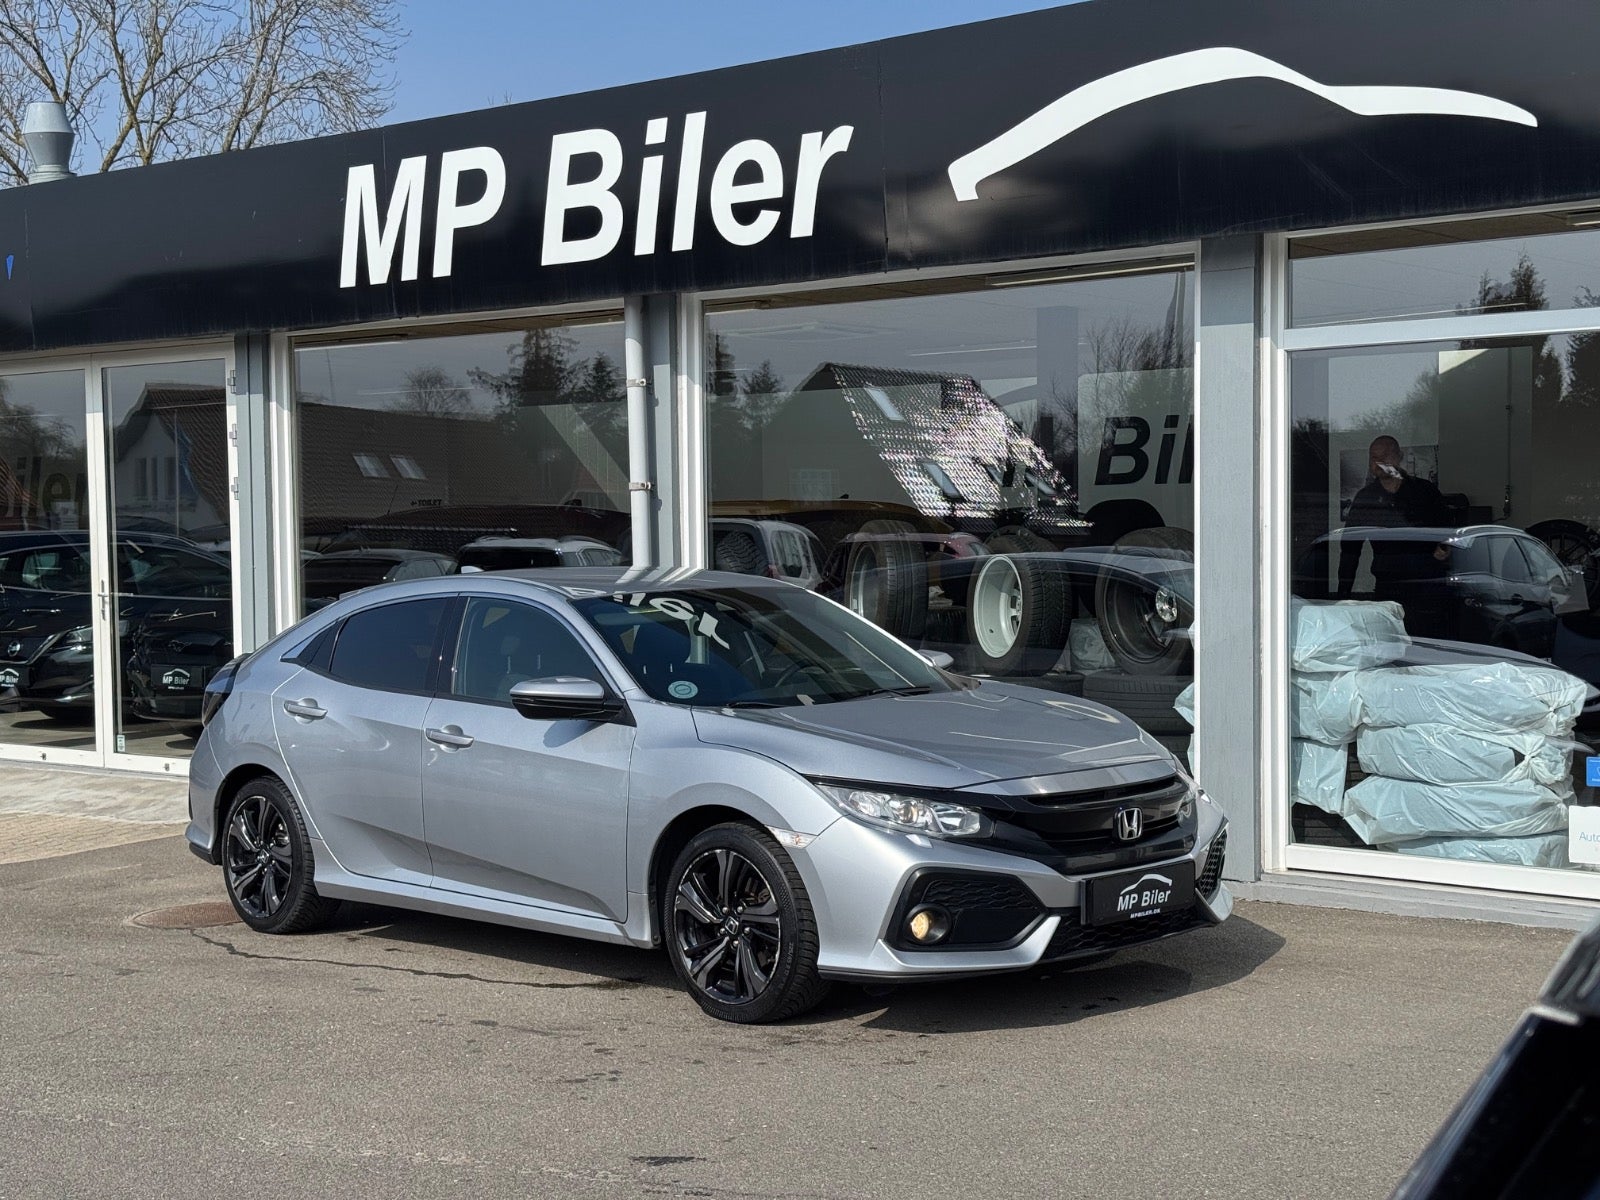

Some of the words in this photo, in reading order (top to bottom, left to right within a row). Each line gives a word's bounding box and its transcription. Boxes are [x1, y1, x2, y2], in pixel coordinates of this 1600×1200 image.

[340, 146, 506, 288] MP
[541, 110, 853, 266] Biler
[1117, 894, 1138, 911] MP
[1141, 889, 1171, 907] Biler
